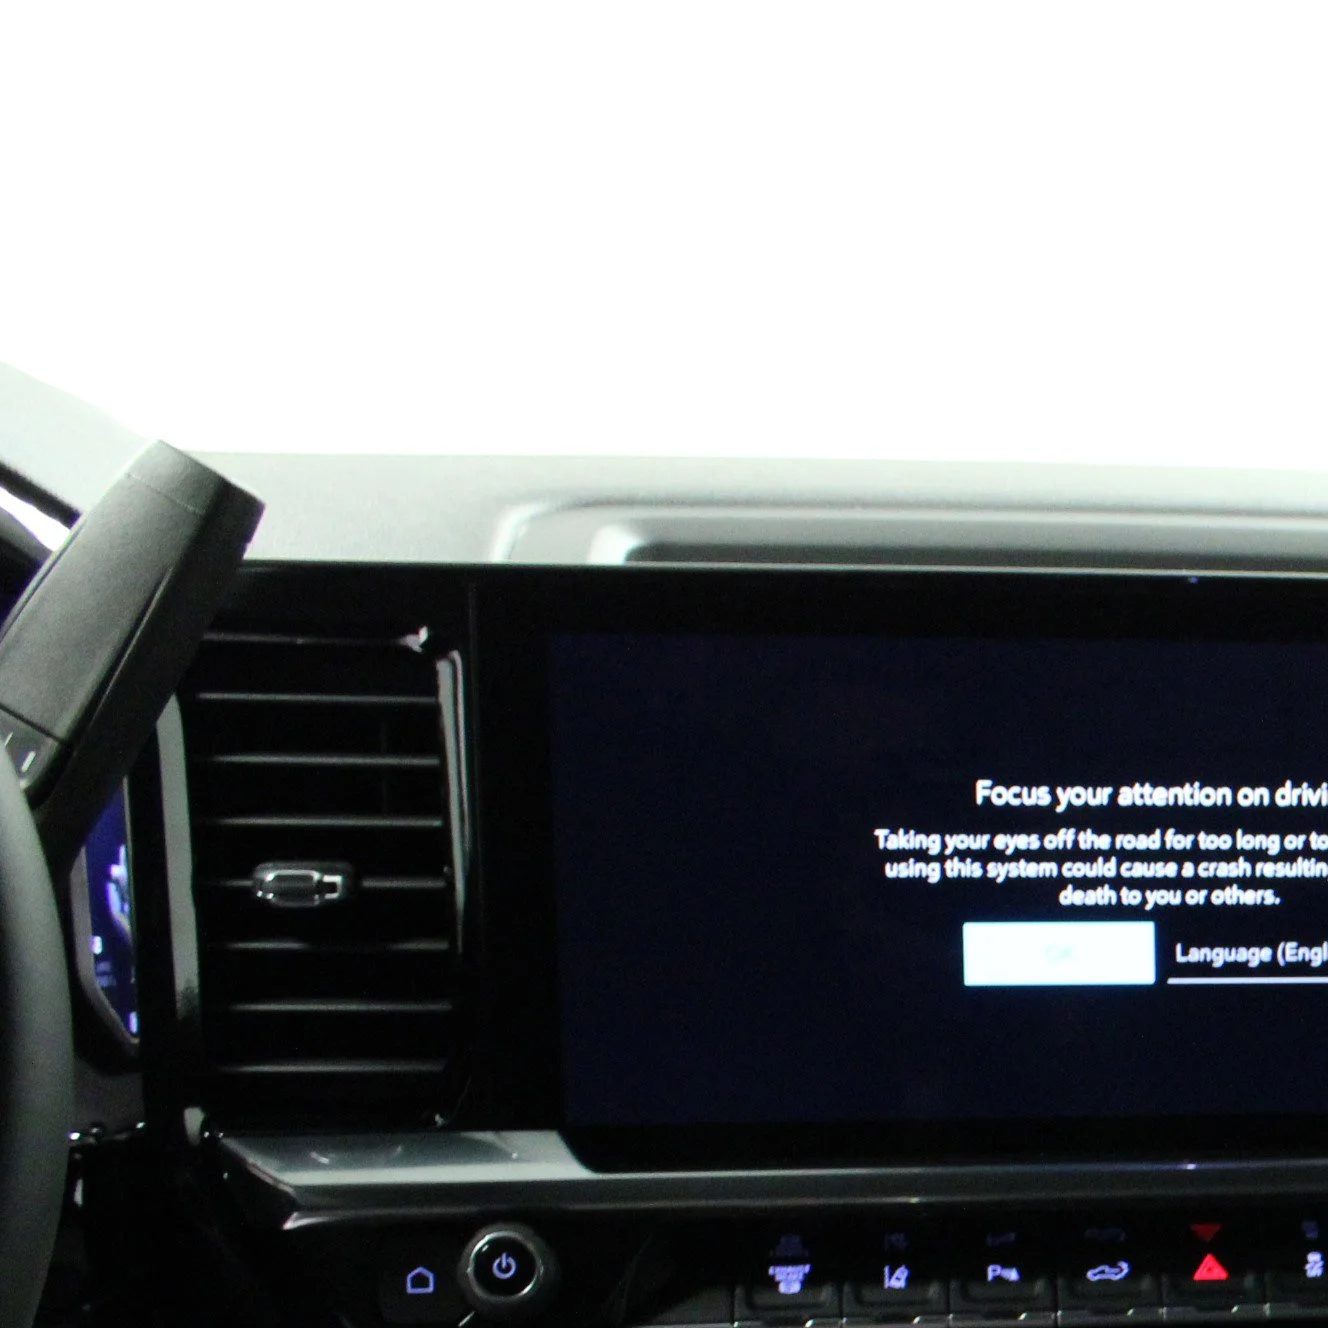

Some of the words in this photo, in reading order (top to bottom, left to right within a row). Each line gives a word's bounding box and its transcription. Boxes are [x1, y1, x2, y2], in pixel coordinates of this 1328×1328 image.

[975, 779, 1051, 806] Focus
[1055, 786, 1113, 813] your
[1117, 781, 1233, 807] attention
[1237, 786, 1270, 807] on
[873, 828, 942, 856] Taking
[944, 834, 991, 856] your
[993, 834, 1041, 856] eyes
[1043, 828, 1076, 850] off
[1077, 828, 1112, 850] the
[1115, 828, 1162, 850] road
[1164, 828, 1195, 850] for
[1197, 831, 1233, 850] too
[1236, 828, 1281, 856] long
[1283, 834, 1307, 851] or
[885, 858, 942, 884] using
[944, 856, 984, 878] this
[986, 859, 1058, 884] system
[1061, 856, 1117, 878] could
[1120, 861, 1178, 878] cause
[1181, 861, 1195, 878] a
[1197, 856, 1252, 878] crash
[1058, 883, 1117, 906] death
[1119, 886, 1142, 906] to
[1144, 889, 1182, 911] you
[1185, 889, 1208, 906] or
[1210, 883, 1281, 906] others.
[1175, 942, 1273, 968] Language
